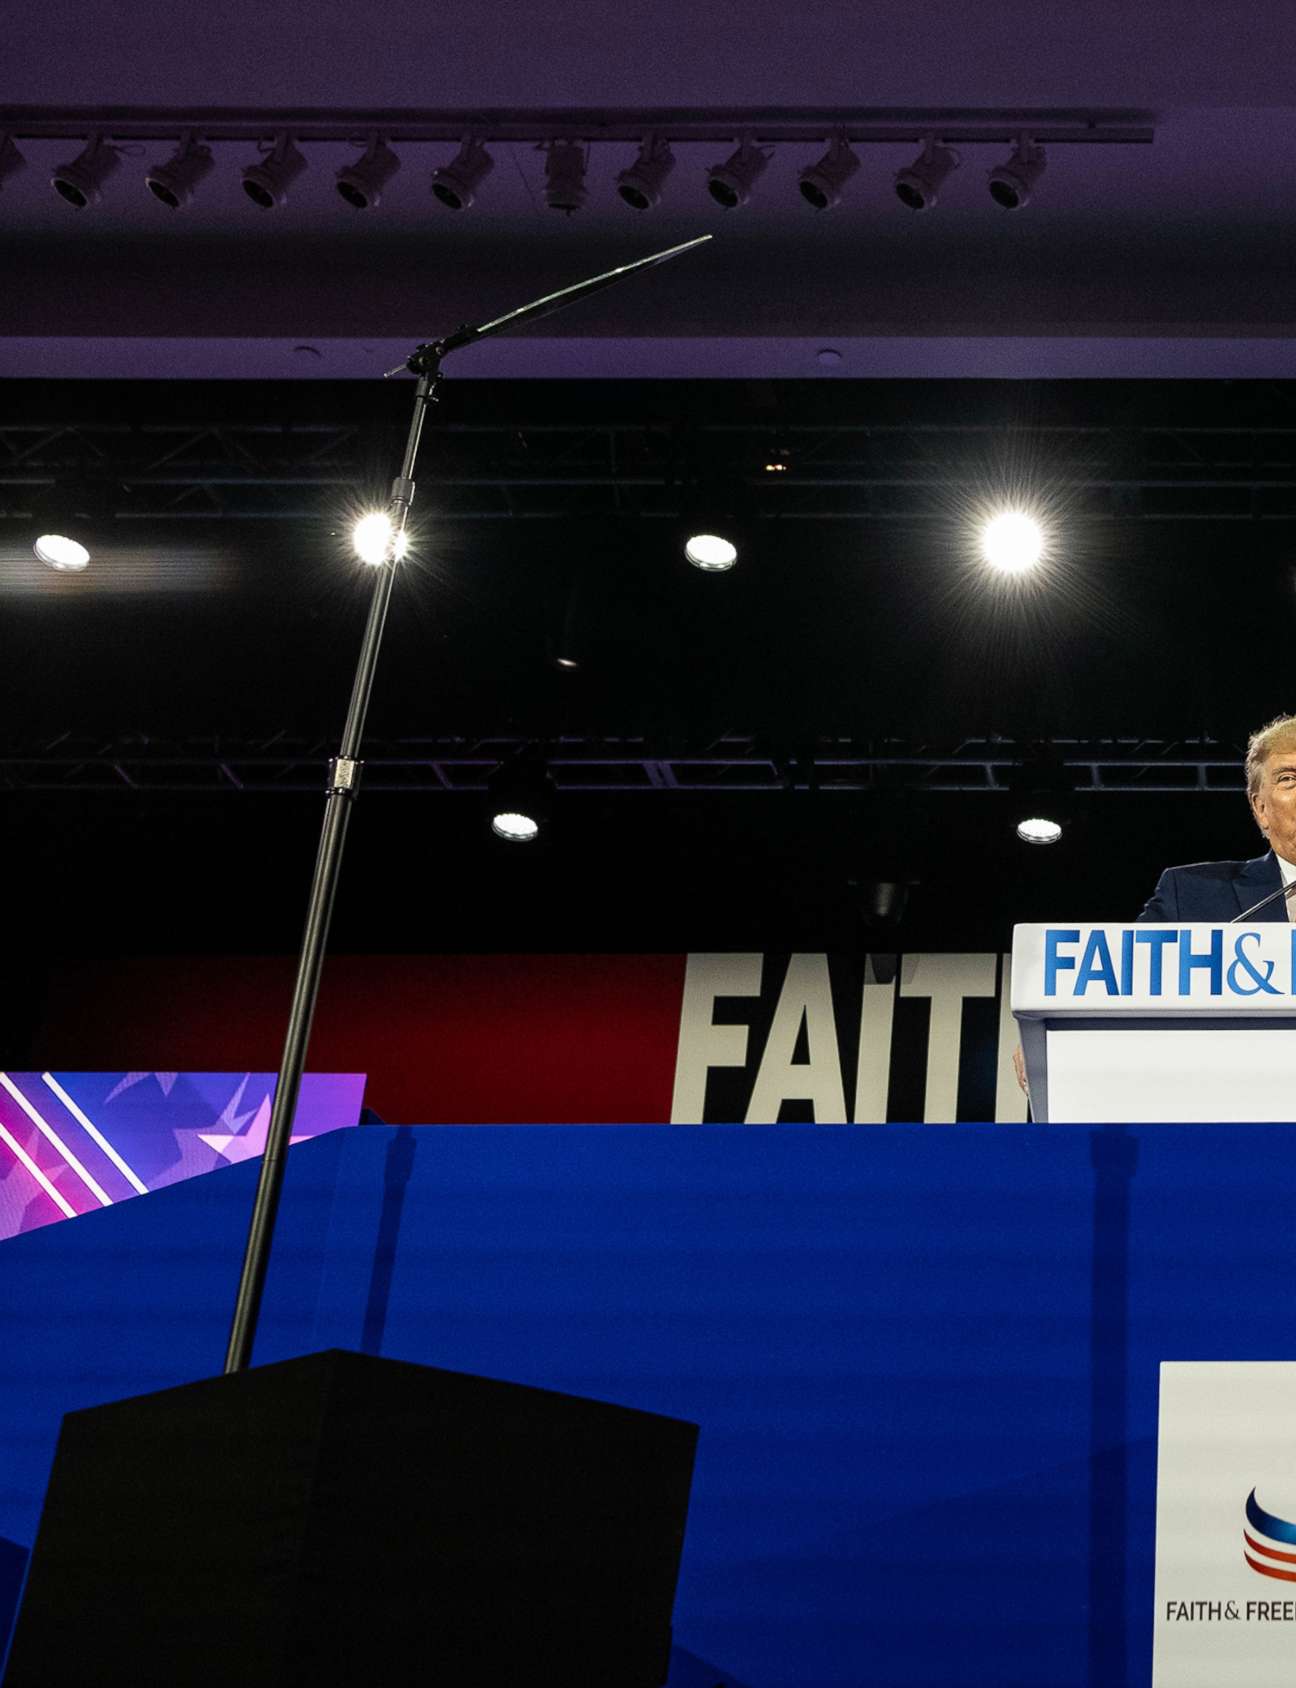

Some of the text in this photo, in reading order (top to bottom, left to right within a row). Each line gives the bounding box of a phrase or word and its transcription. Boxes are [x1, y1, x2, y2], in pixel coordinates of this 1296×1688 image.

[1044, 929, 1223, 996] FAITH
[1226, 932, 1286, 996] &
[1166, 1601, 1222, 1621] FAITH
[1224, 1600, 1242, 1621] &
